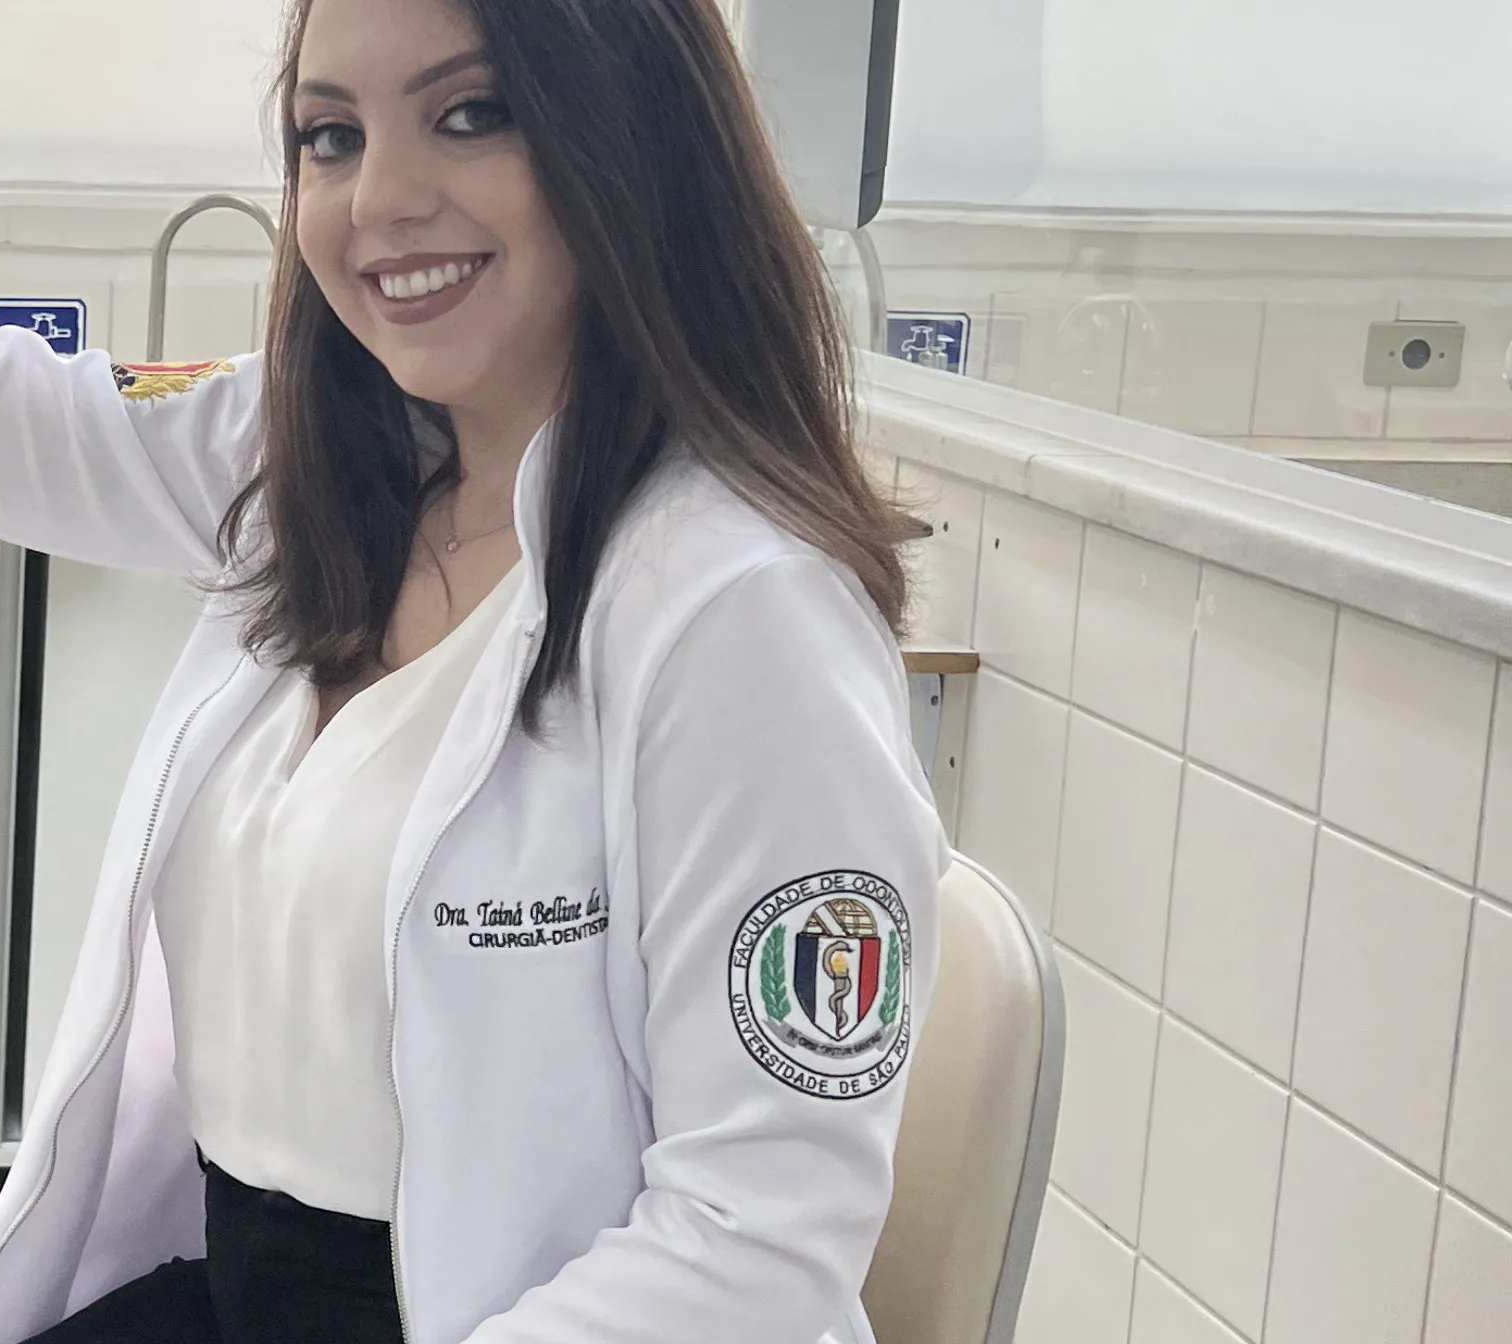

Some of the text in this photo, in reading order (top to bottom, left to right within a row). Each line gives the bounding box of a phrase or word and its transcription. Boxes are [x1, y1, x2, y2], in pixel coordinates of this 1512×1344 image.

[434, 902, 469, 927] Dra.
[477, 899, 523, 927] Tainá
[733, 881, 815, 969] FACULDADE
[820, 875, 846, 890] DE
[732, 993, 828, 1093] UNIVERSIDADE
[839, 1080, 861, 1094] DE
[869, 1061, 894, 1086] SÃO
